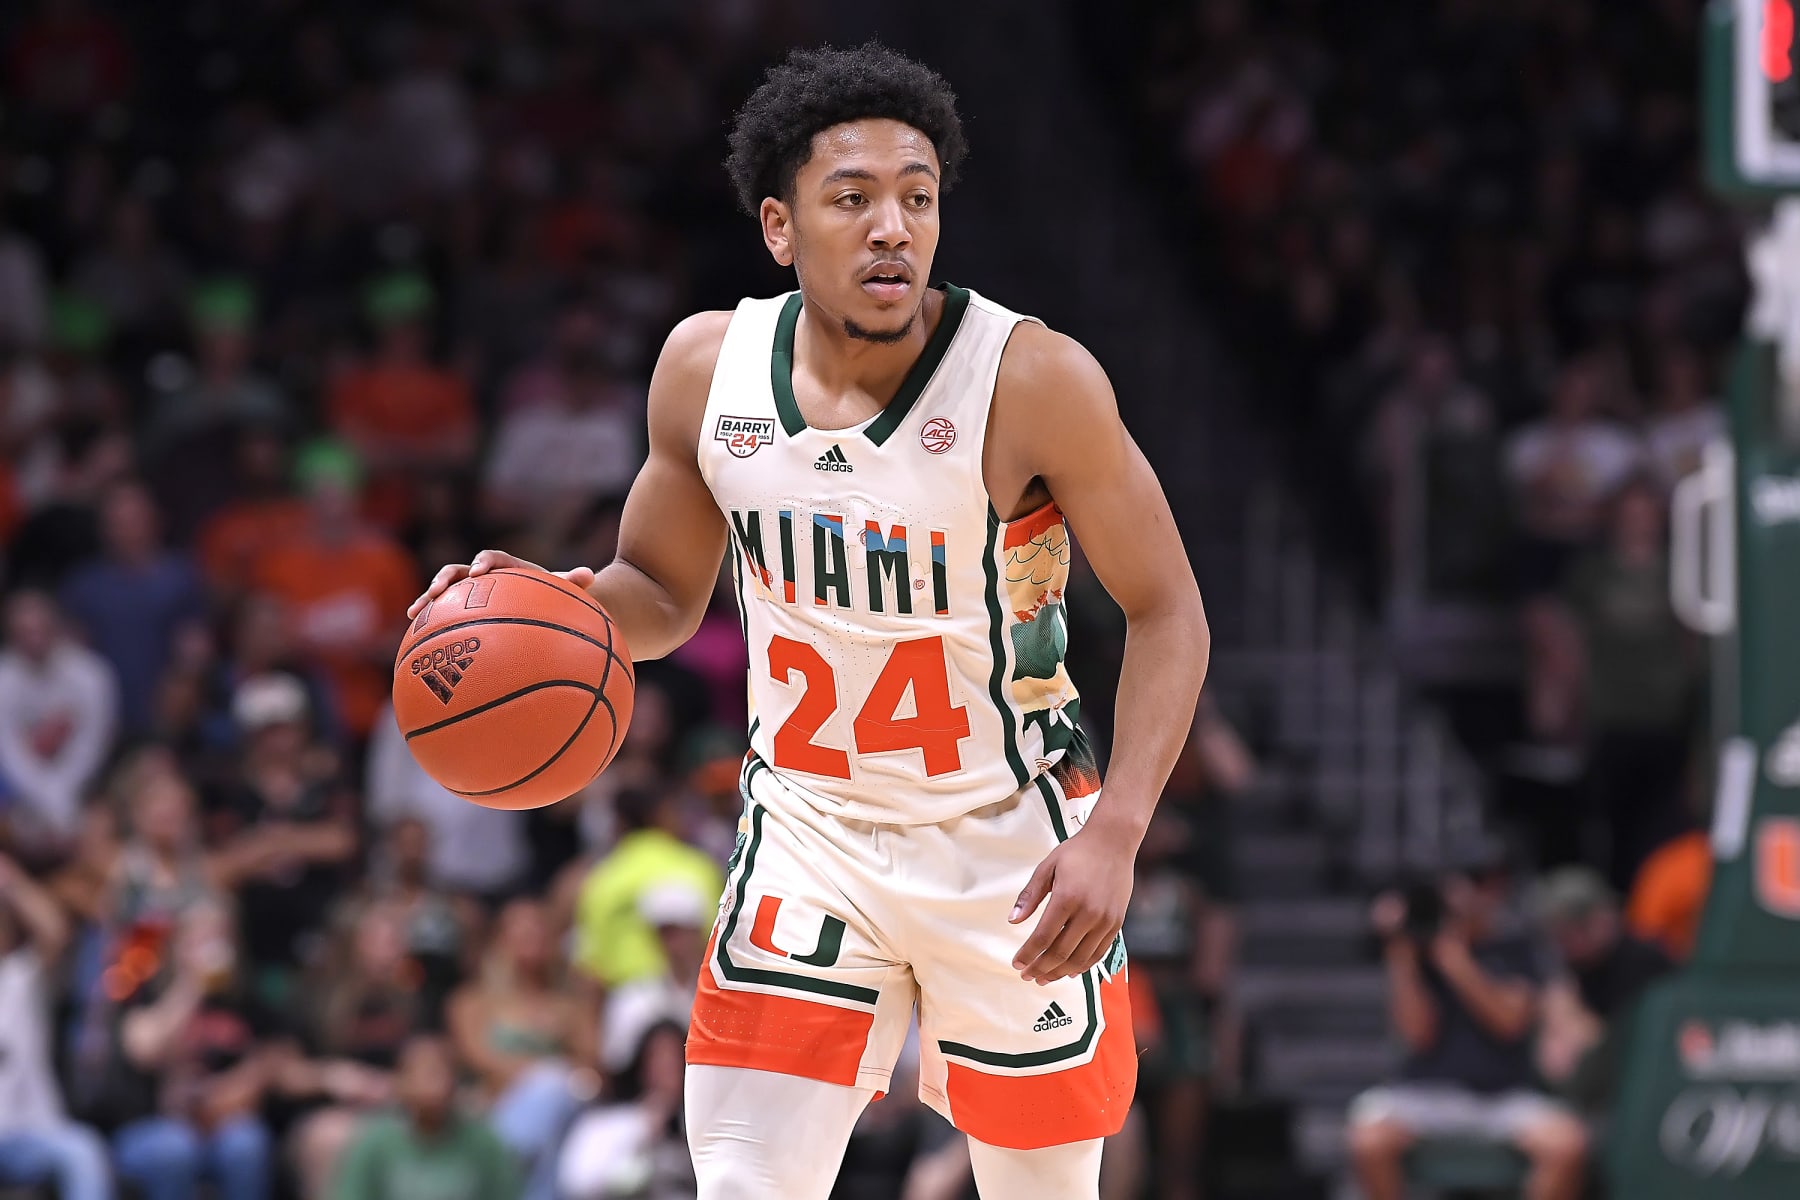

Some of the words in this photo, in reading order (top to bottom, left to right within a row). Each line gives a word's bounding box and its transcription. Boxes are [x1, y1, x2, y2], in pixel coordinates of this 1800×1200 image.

[721, 420, 771, 434] BARRY
[925, 429, 955, 437] ACC
[731, 433, 757, 448] 24
[813, 460, 854, 473] adidas
[730, 509, 949, 615] MIAMI
[411, 636, 481, 676] adidas
[767, 634, 971, 781] 24
[749, 894, 847, 968] U
[1033, 1016, 1073, 1032] adidas
